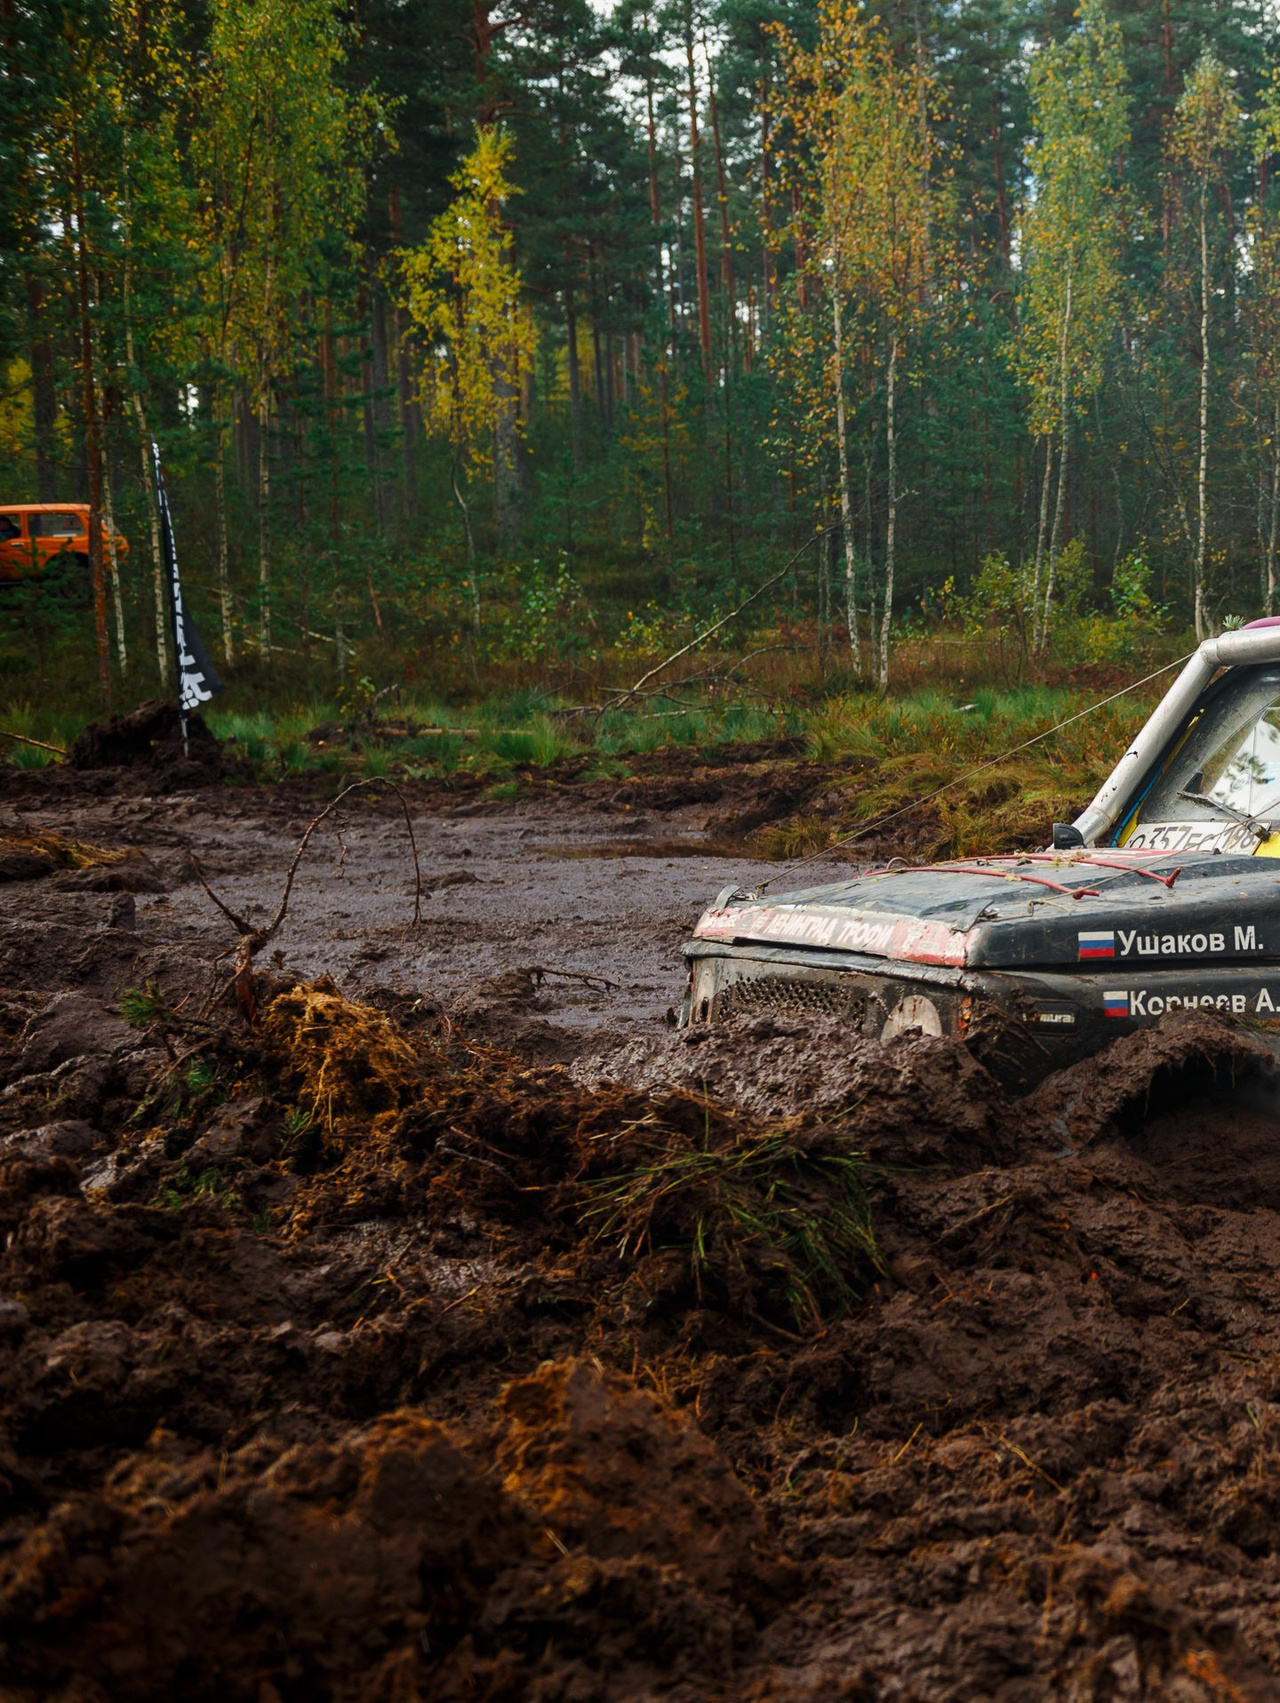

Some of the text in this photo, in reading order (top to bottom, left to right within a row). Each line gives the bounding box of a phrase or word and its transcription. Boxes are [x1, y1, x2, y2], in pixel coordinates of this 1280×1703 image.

[838, 921, 895, 948] ТРОФИ
[1117, 925, 1264, 956] Ушаков М.
